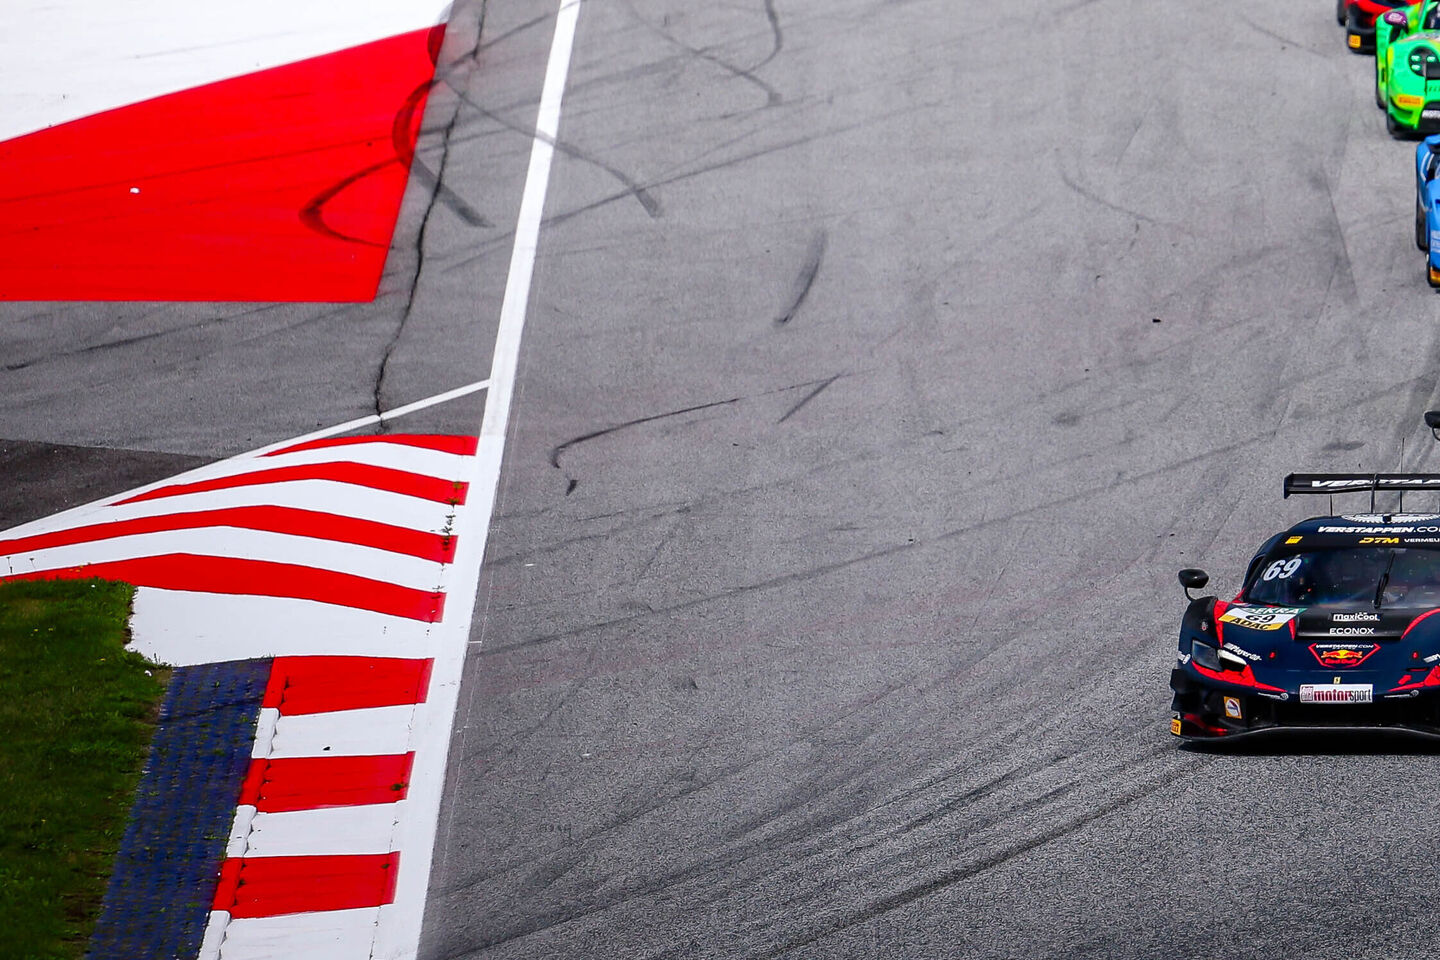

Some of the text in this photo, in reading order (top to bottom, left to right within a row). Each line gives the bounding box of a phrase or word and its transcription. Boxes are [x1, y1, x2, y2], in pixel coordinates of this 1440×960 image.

[1262, 557, 1302, 581] 69
[1231, 618, 1271, 631] ADAC
[1245, 614, 1276, 623] 69
[1329, 627, 1375, 635] ECONOX
[1313, 689, 1373, 704] motorsport
